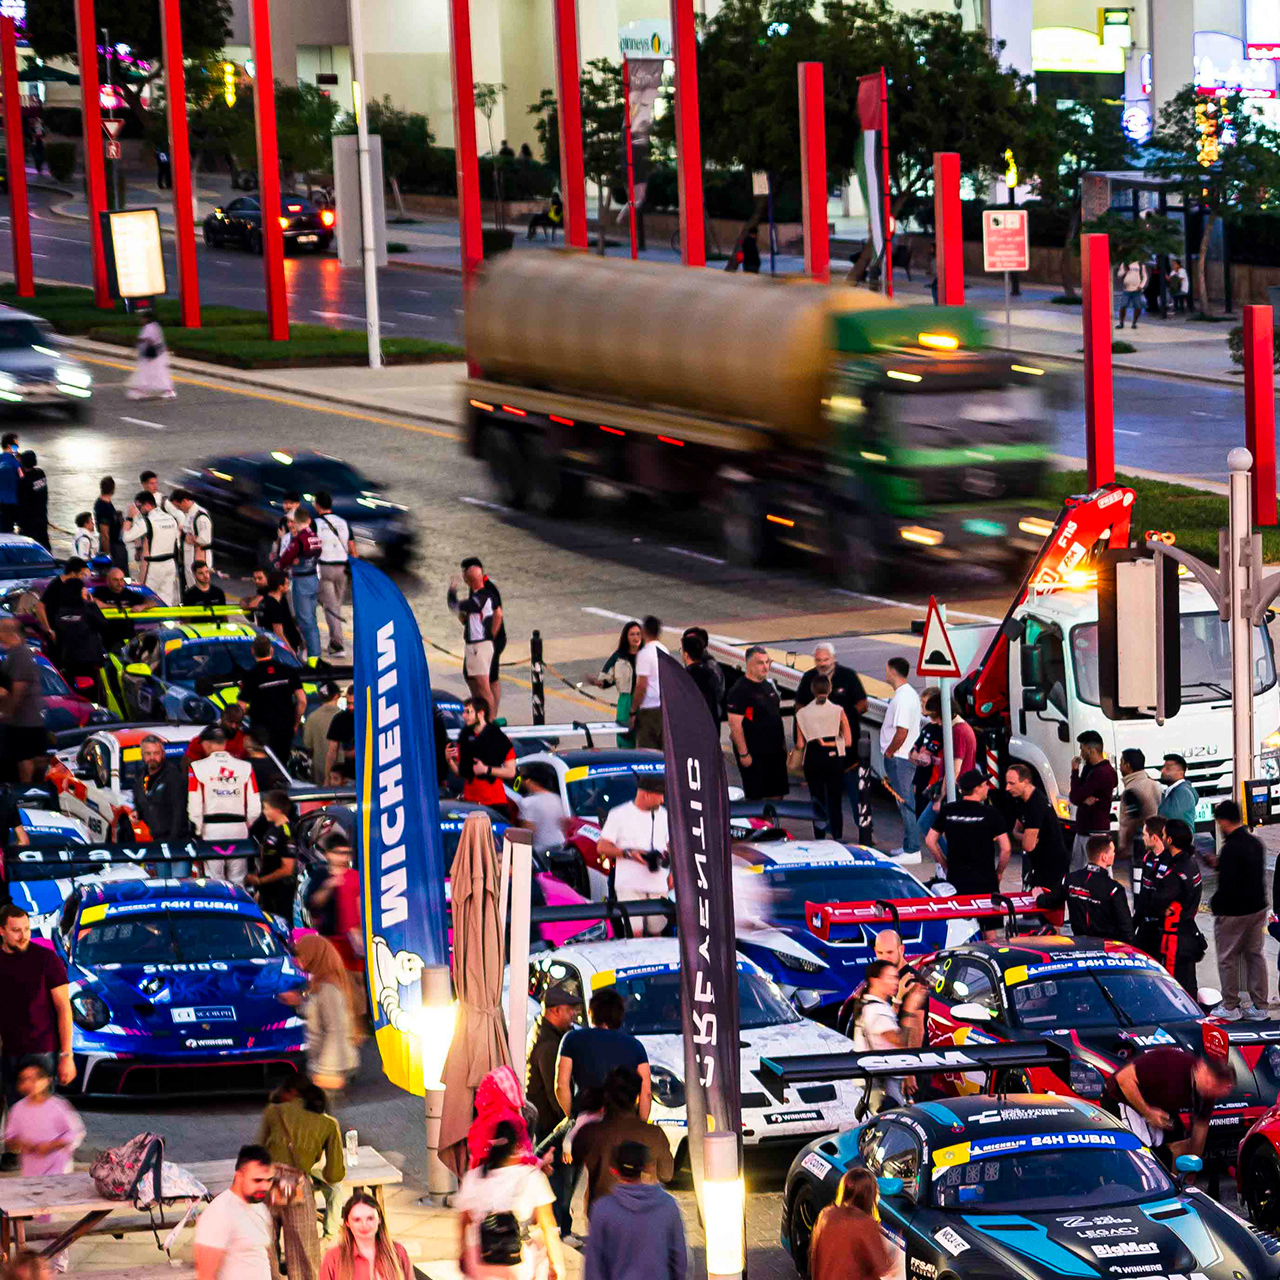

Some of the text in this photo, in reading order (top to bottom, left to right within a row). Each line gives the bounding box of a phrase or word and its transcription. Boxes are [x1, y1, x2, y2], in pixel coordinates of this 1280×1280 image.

[1077, 959, 1104, 969] 24H
[1107, 958, 1147, 969] DUBAI
[1031, 1135, 1064, 1146] 24H
[1066, 1134, 1116, 1145] DUBAI
[1091, 1242, 1160, 1258] BigMat
